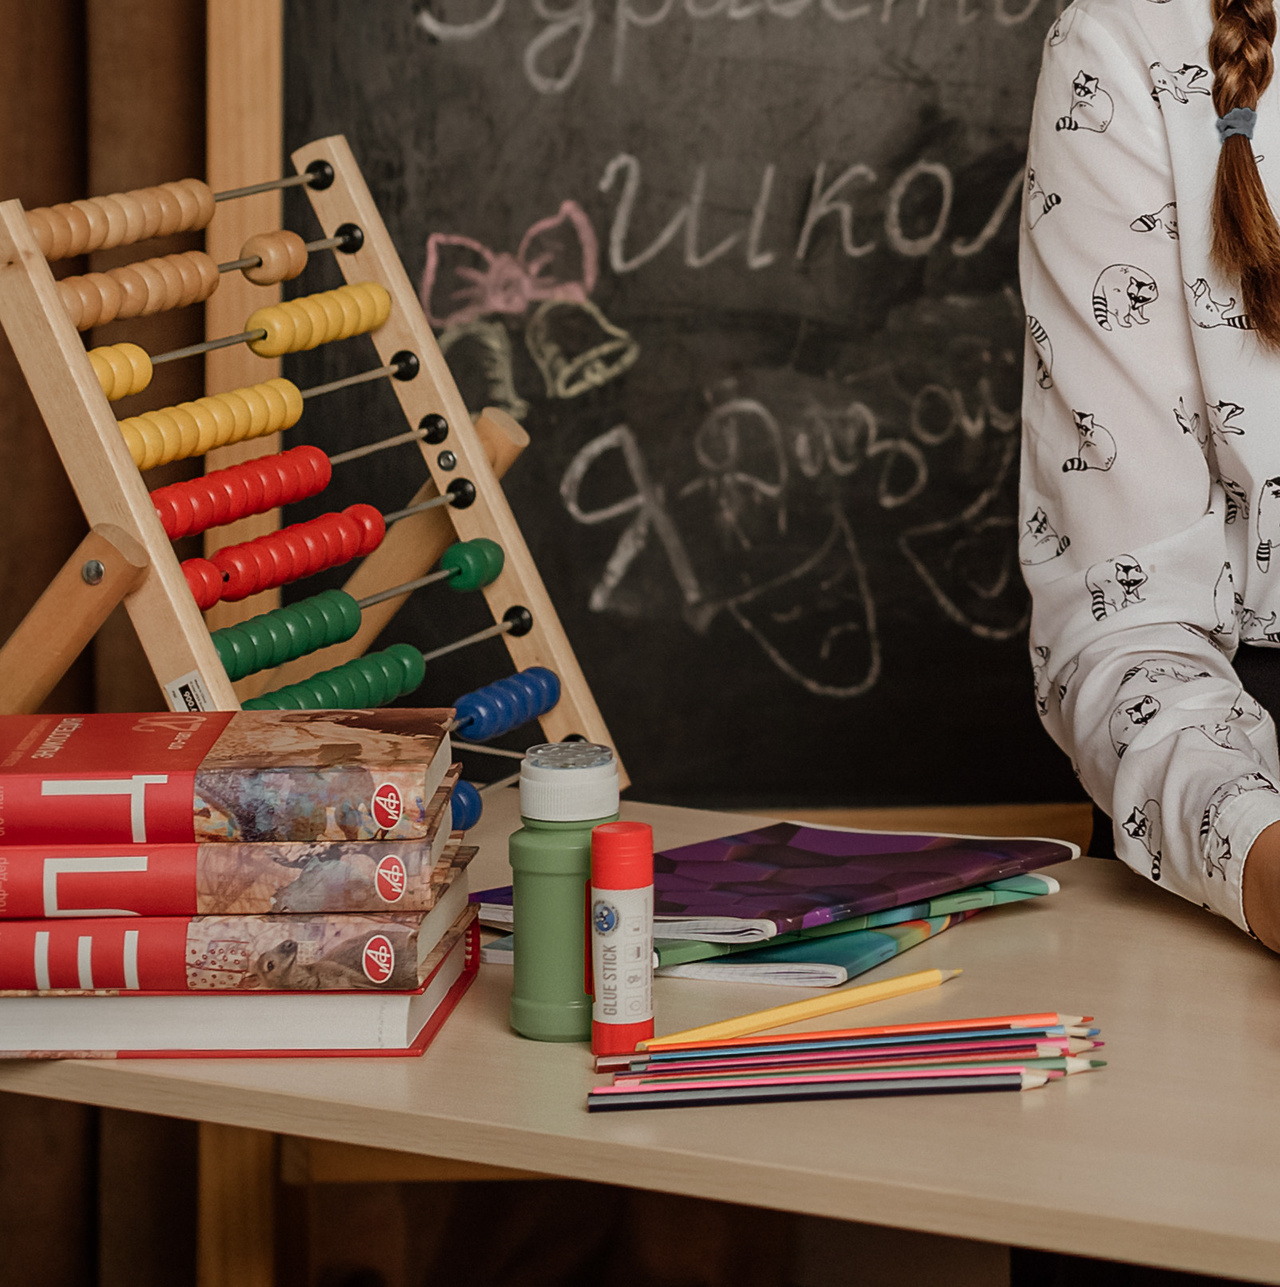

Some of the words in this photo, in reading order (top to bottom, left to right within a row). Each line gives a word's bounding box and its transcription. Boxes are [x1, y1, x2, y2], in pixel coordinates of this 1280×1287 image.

[132, 715, 207, 733] 20
[602, 944, 617, 980] STICK
[603, 983, 617, 1016] GLUE
